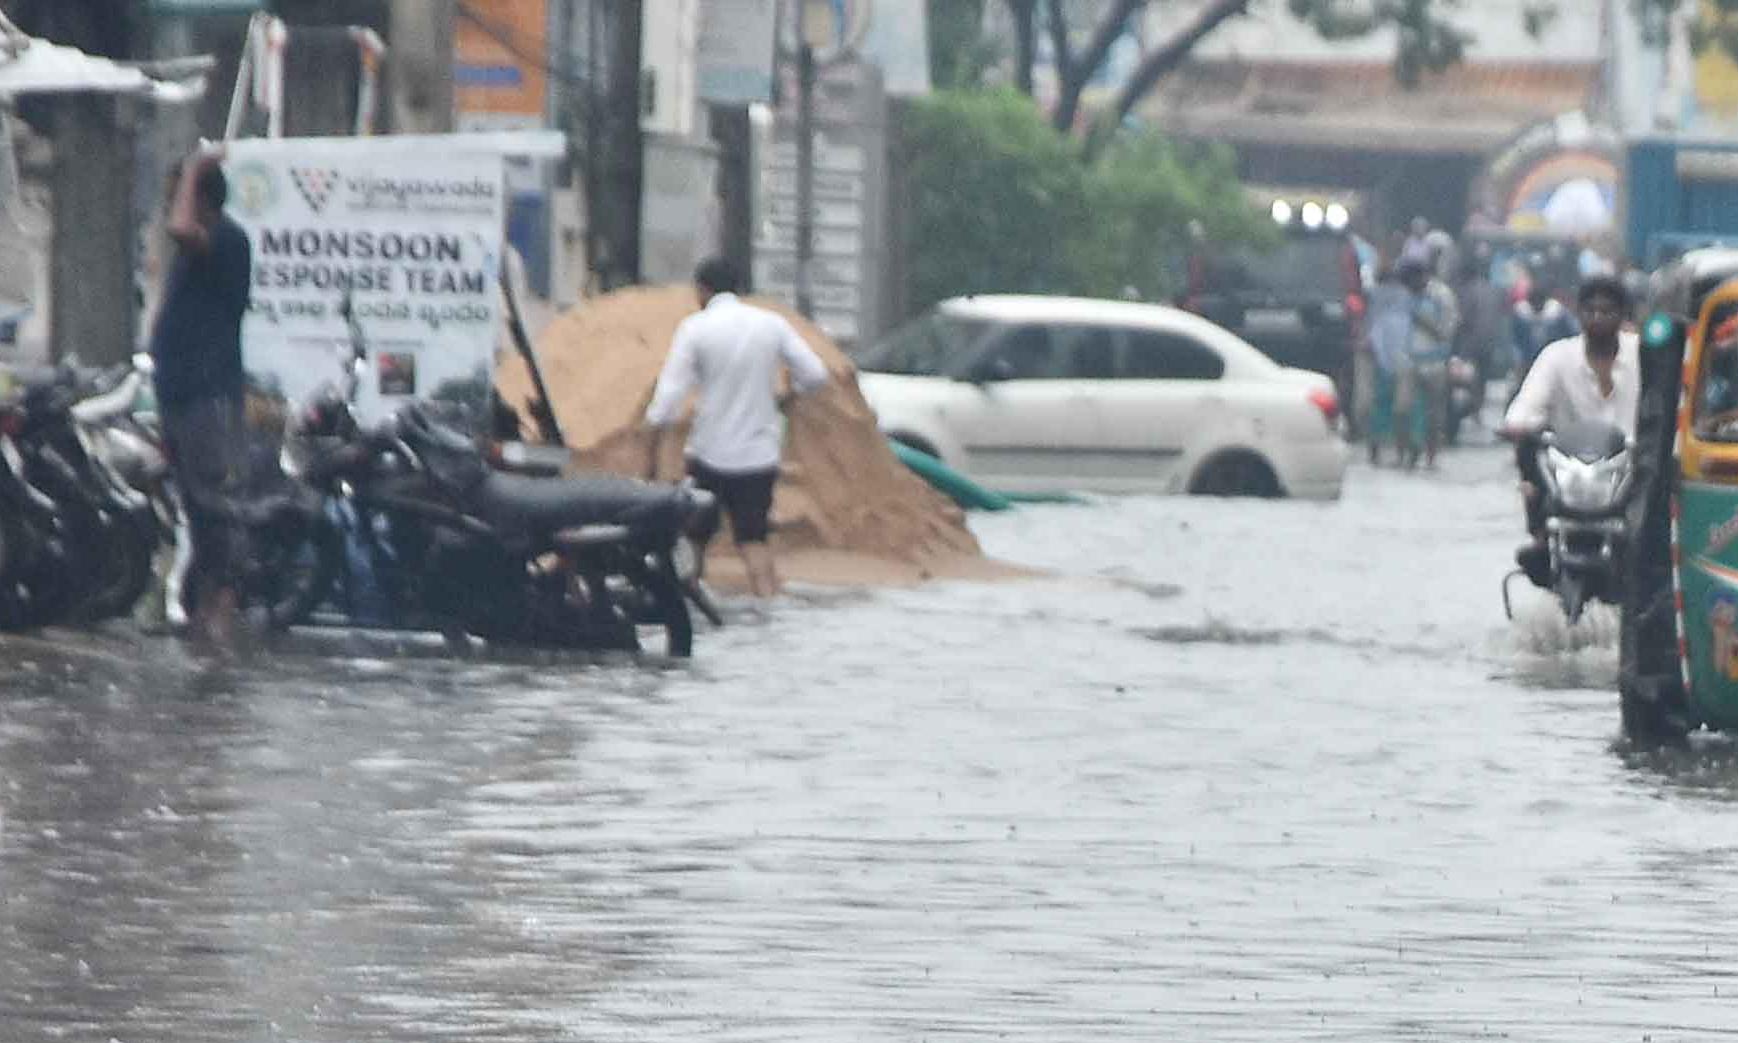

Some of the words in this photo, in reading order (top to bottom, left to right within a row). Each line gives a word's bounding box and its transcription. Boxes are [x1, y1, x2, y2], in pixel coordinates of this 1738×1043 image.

[261, 228, 460, 262] MONSOON
[254, 263, 391, 289] ESPONSE
[404, 267, 484, 294] TEAM
